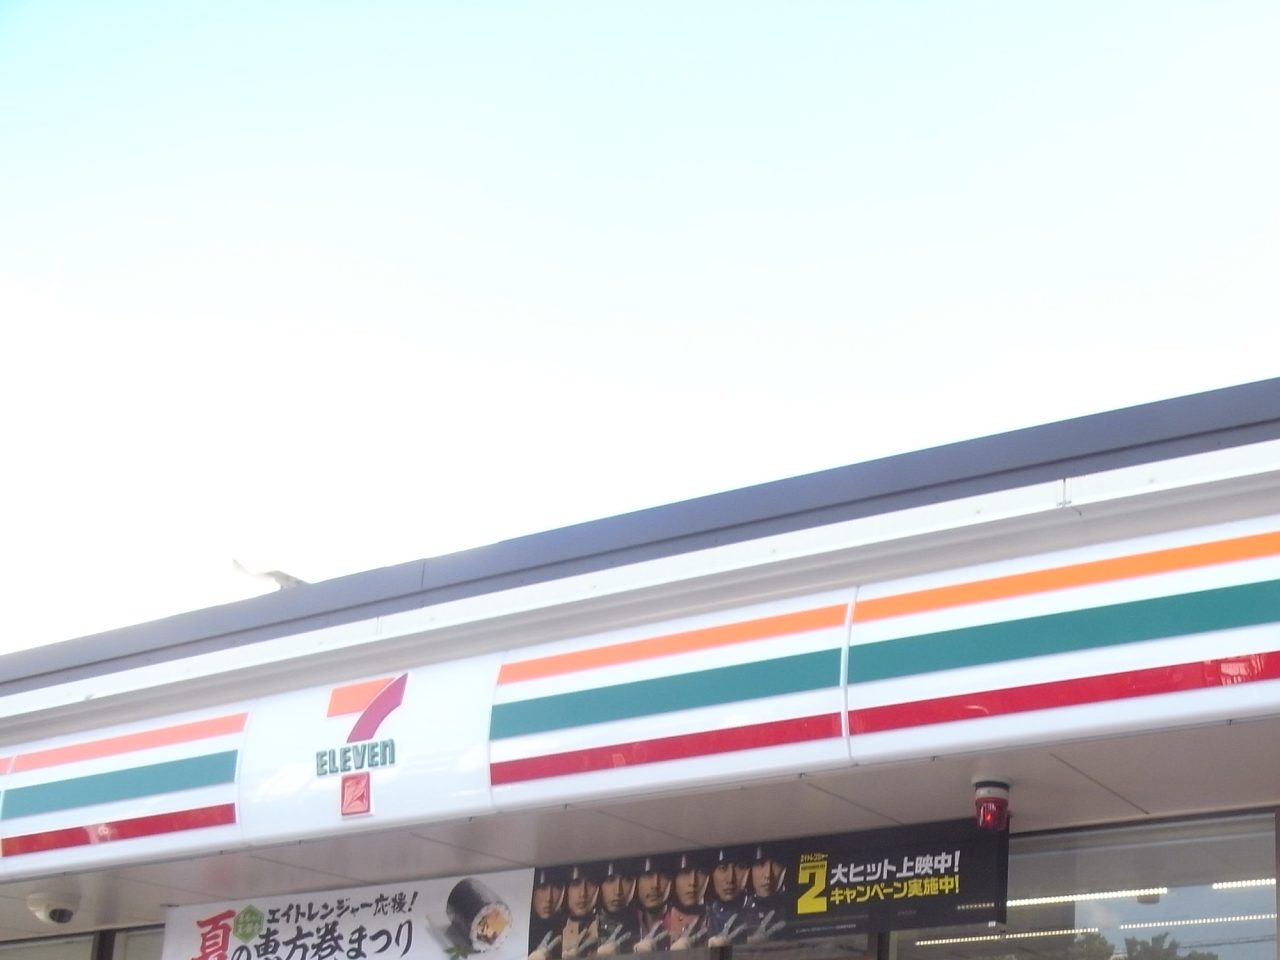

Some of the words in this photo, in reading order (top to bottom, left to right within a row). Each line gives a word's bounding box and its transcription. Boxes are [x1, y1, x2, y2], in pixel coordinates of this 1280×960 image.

[830, 850, 961, 885] 大ヒット上映中!
[797, 862, 828, 914] 2
[830, 875, 960, 904] キャンペーン実施中!
